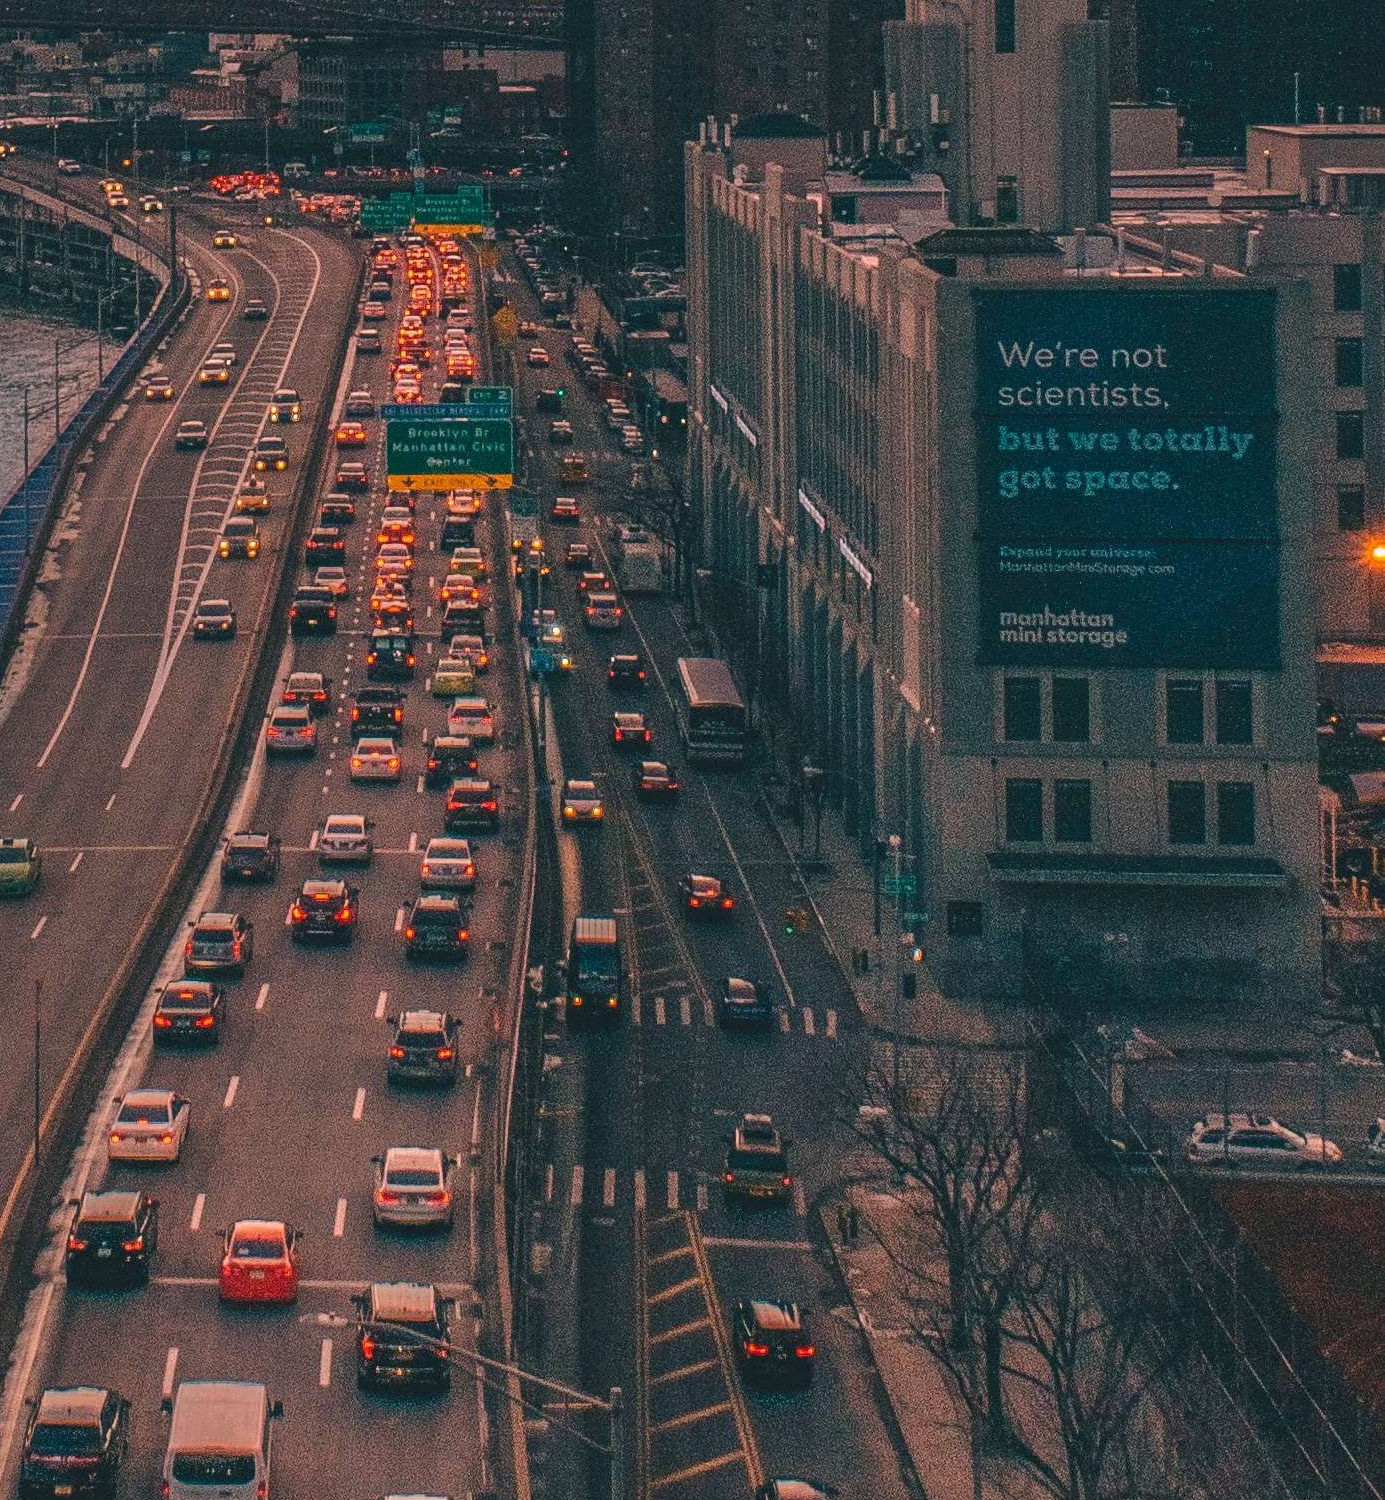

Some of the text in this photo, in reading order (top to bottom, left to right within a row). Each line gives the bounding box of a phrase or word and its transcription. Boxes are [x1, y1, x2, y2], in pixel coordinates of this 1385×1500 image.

[997, 340, 1168, 369] We're not
[497, 390, 508, 400] 2
[998, 379, 1170, 408] scientists,
[408, 427, 469, 439] Brooklyn
[998, 424, 1254, 460] but we totally
[392, 441, 507, 453] Manhattan Civic
[998, 466, 1180, 499] got space.
[999, 545, 1053, 560] Expand
[1057, 548, 1087, 560] your
[999, 604, 1114, 627] manhattan
[999, 626, 1129, 648] mini storage
